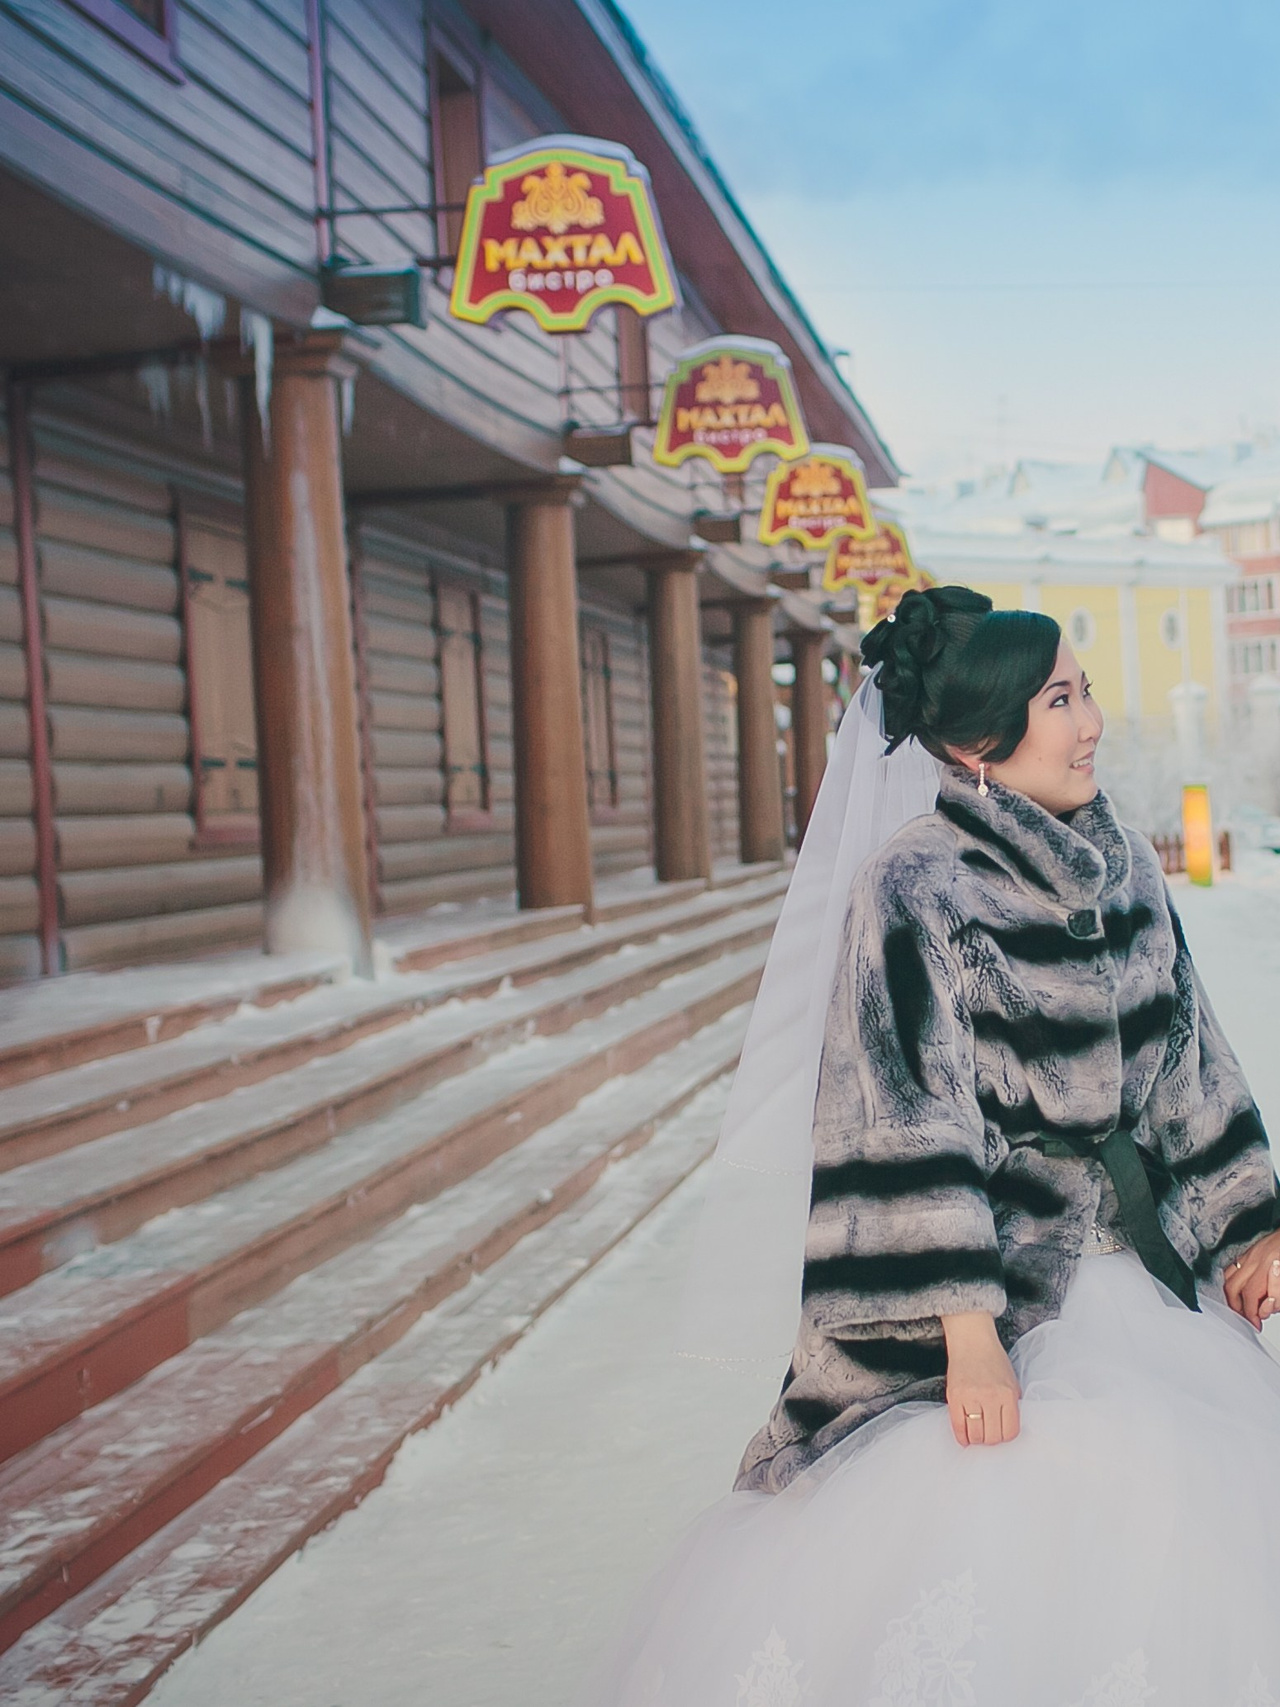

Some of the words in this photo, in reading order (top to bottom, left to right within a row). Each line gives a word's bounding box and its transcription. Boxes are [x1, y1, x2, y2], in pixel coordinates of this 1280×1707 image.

[483, 232, 644, 272] МАХТАЛ
[508, 268, 615, 293] бистро
[676, 402, 788, 433] МАХТАЛ
